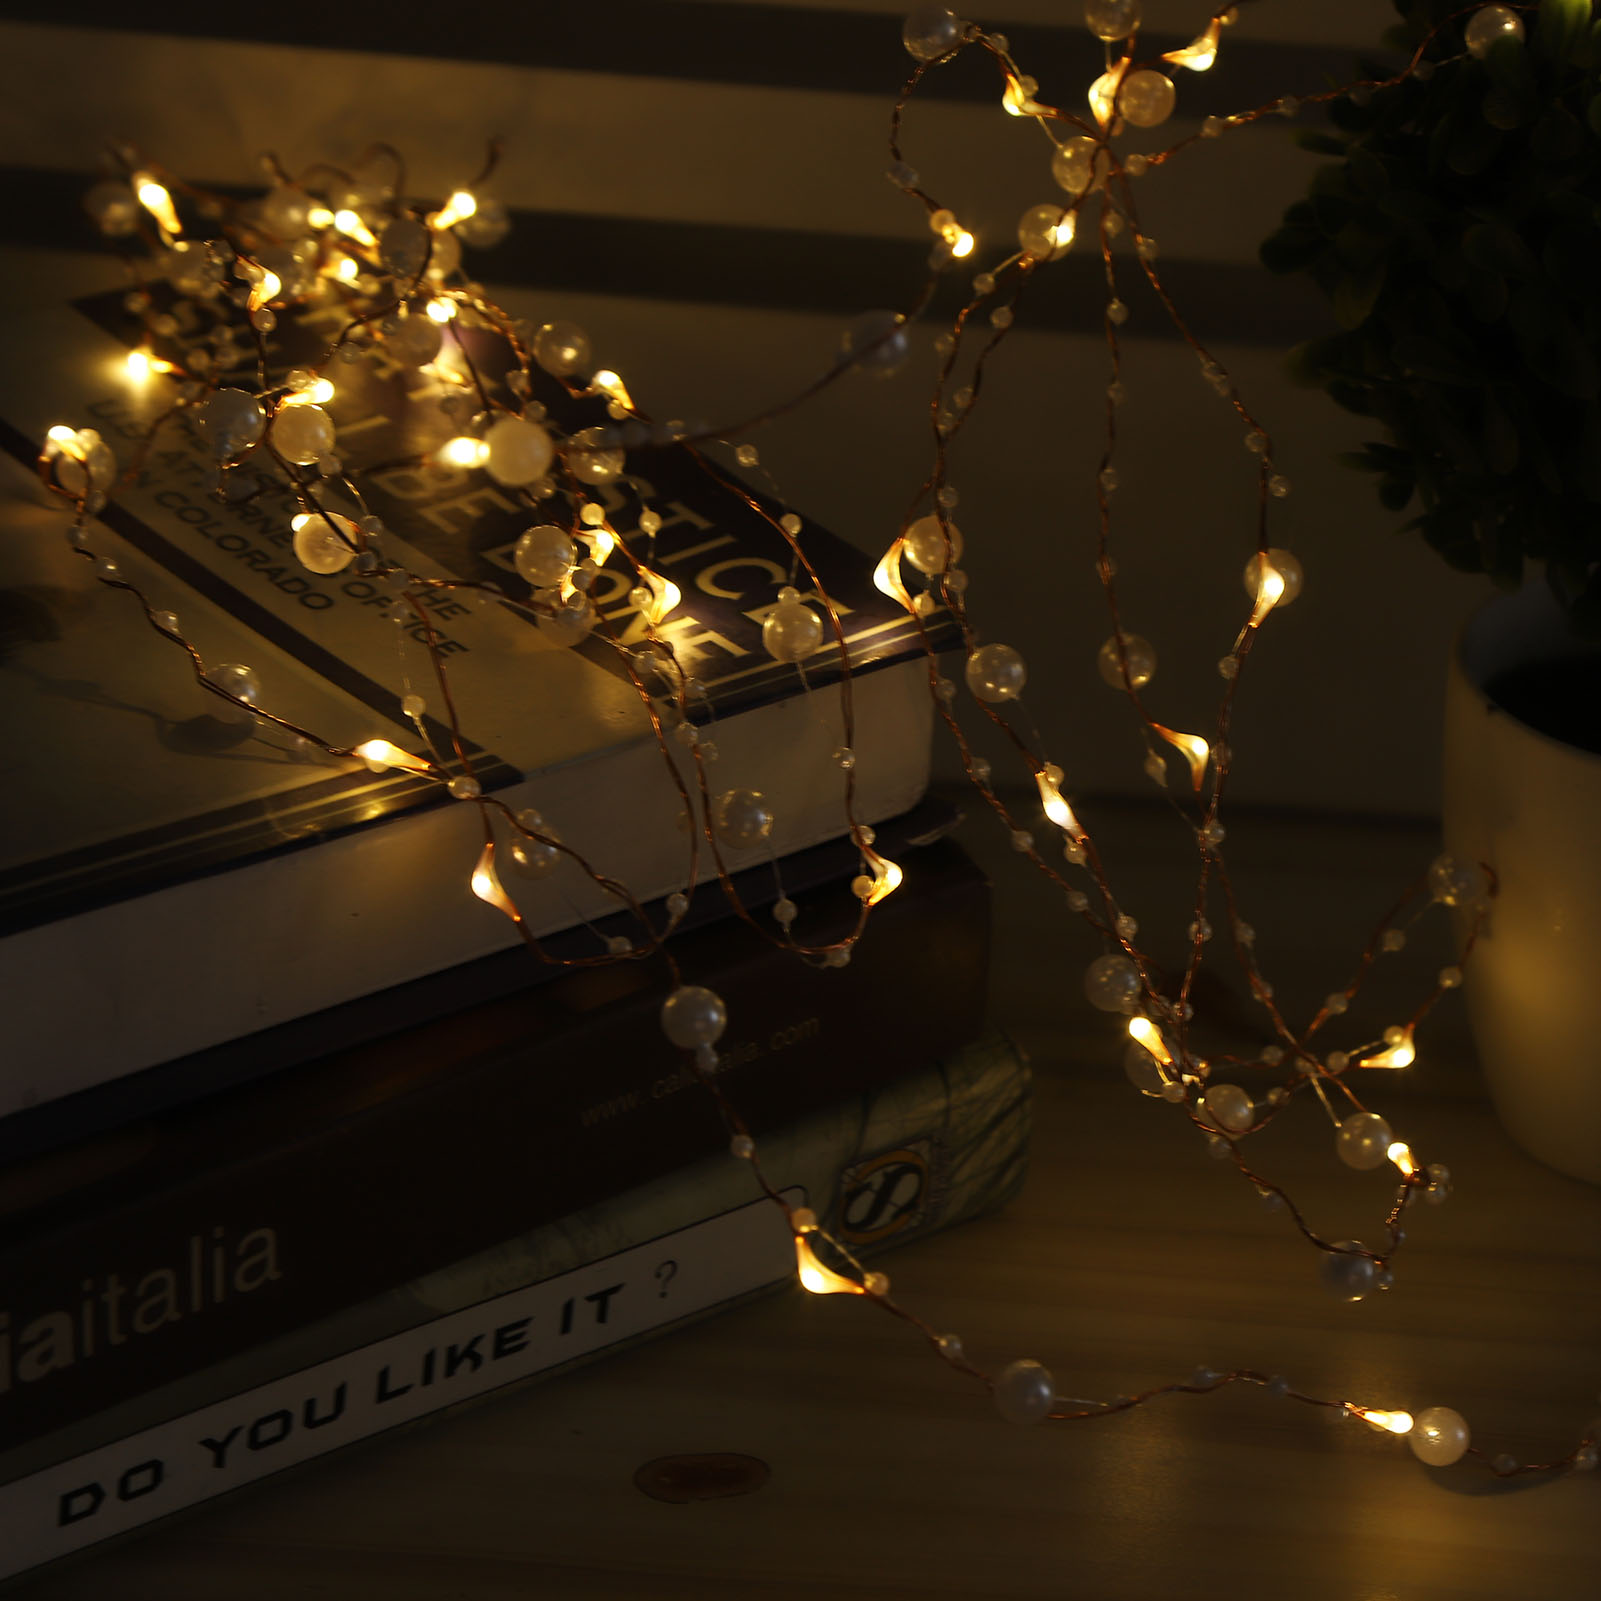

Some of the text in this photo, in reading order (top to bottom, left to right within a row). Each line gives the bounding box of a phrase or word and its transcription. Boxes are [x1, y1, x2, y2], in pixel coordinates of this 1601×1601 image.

[152, 487, 336, 612] COLORADO
[372, 468, 523, 534] BE
[59, 1459, 163, 1526] DO
[198, 1382, 346, 1468] YOU
[376, 1316, 534, 1404] LIKE
[560, 1282, 626, 1335] IT
